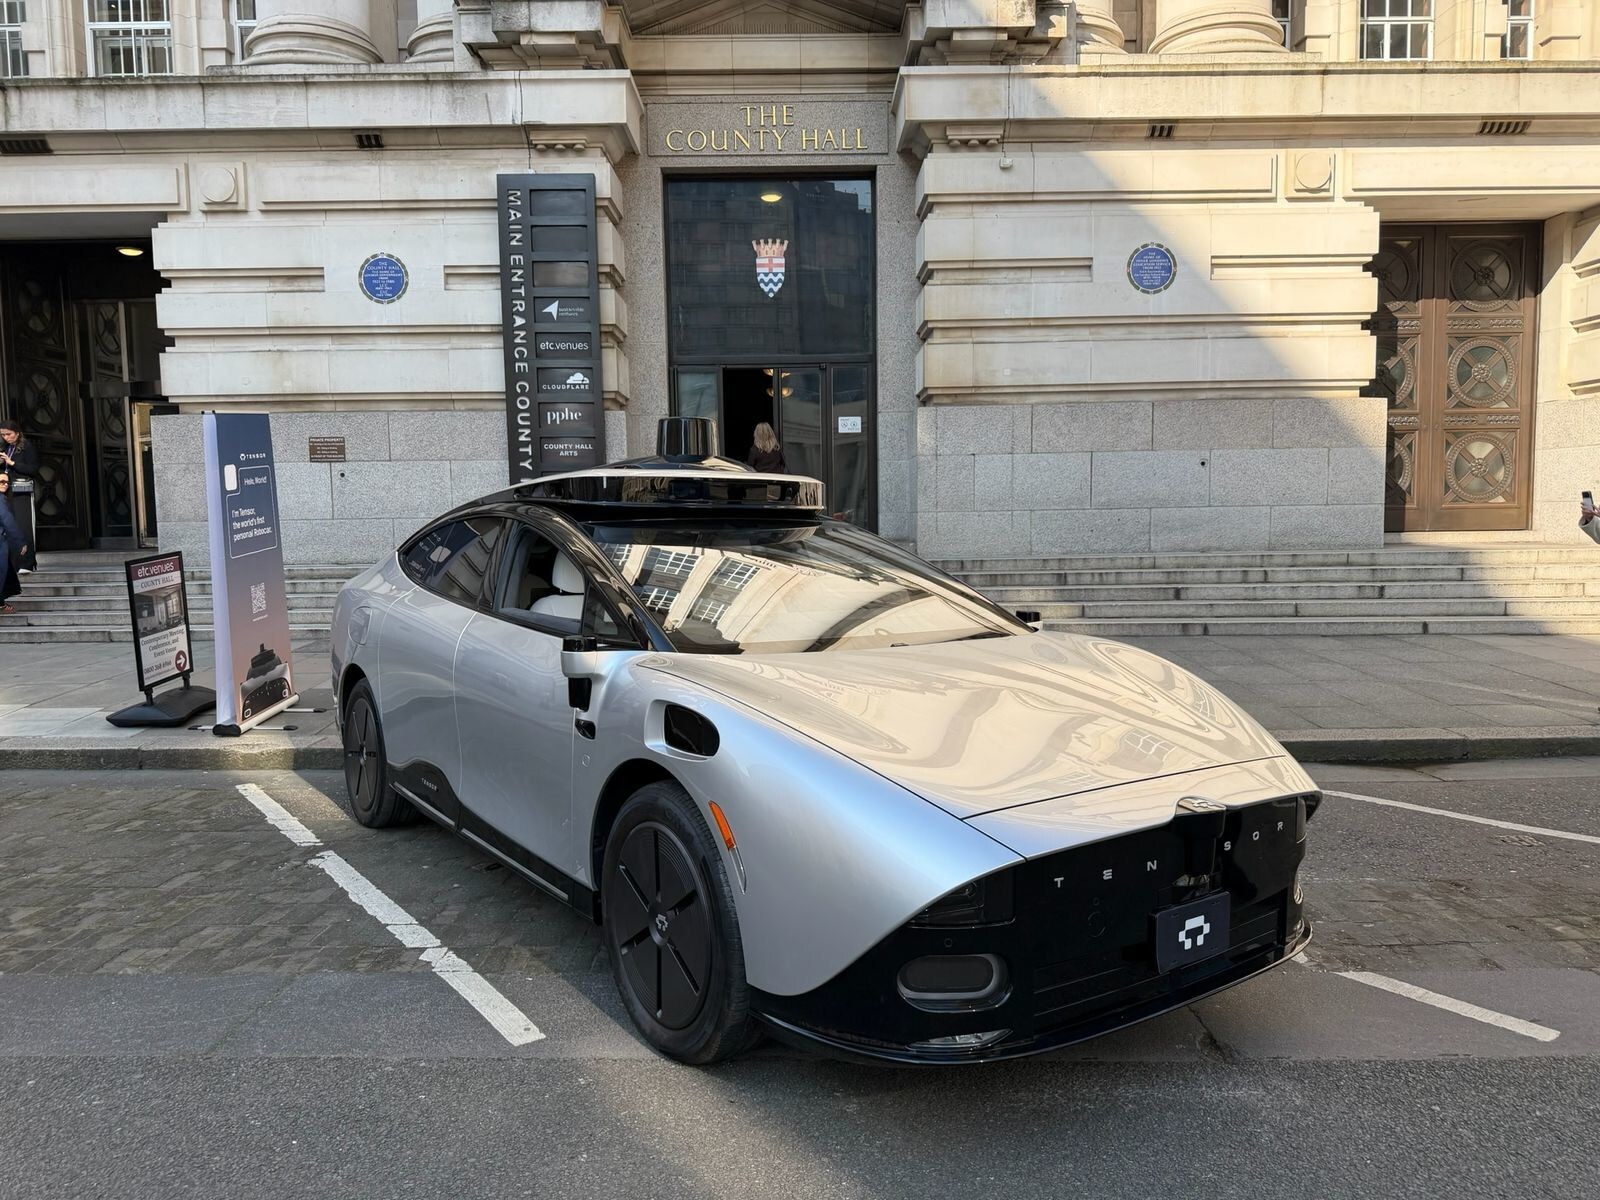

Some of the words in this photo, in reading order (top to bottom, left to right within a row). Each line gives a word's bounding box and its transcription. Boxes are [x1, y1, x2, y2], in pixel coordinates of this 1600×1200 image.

[740, 105, 795, 127] THE
[665, 129, 789, 151] COUNTY
[801, 128, 869, 150] HALL
[507, 189, 523, 246] MAIN
[509, 254, 529, 374] ENTRANCE
[540, 340, 589, 350] etc.venues
[547, 408, 582, 424] pphe
[515, 381, 533, 471] COUNTY
[240, 518, 257, 528] world's
[257, 516, 265, 524] first
[234, 530, 253, 542] personal
[138, 561, 174, 578] etc.venues
[140, 578, 160, 589] COUNTY
[161, 575, 174, 584] HALL
